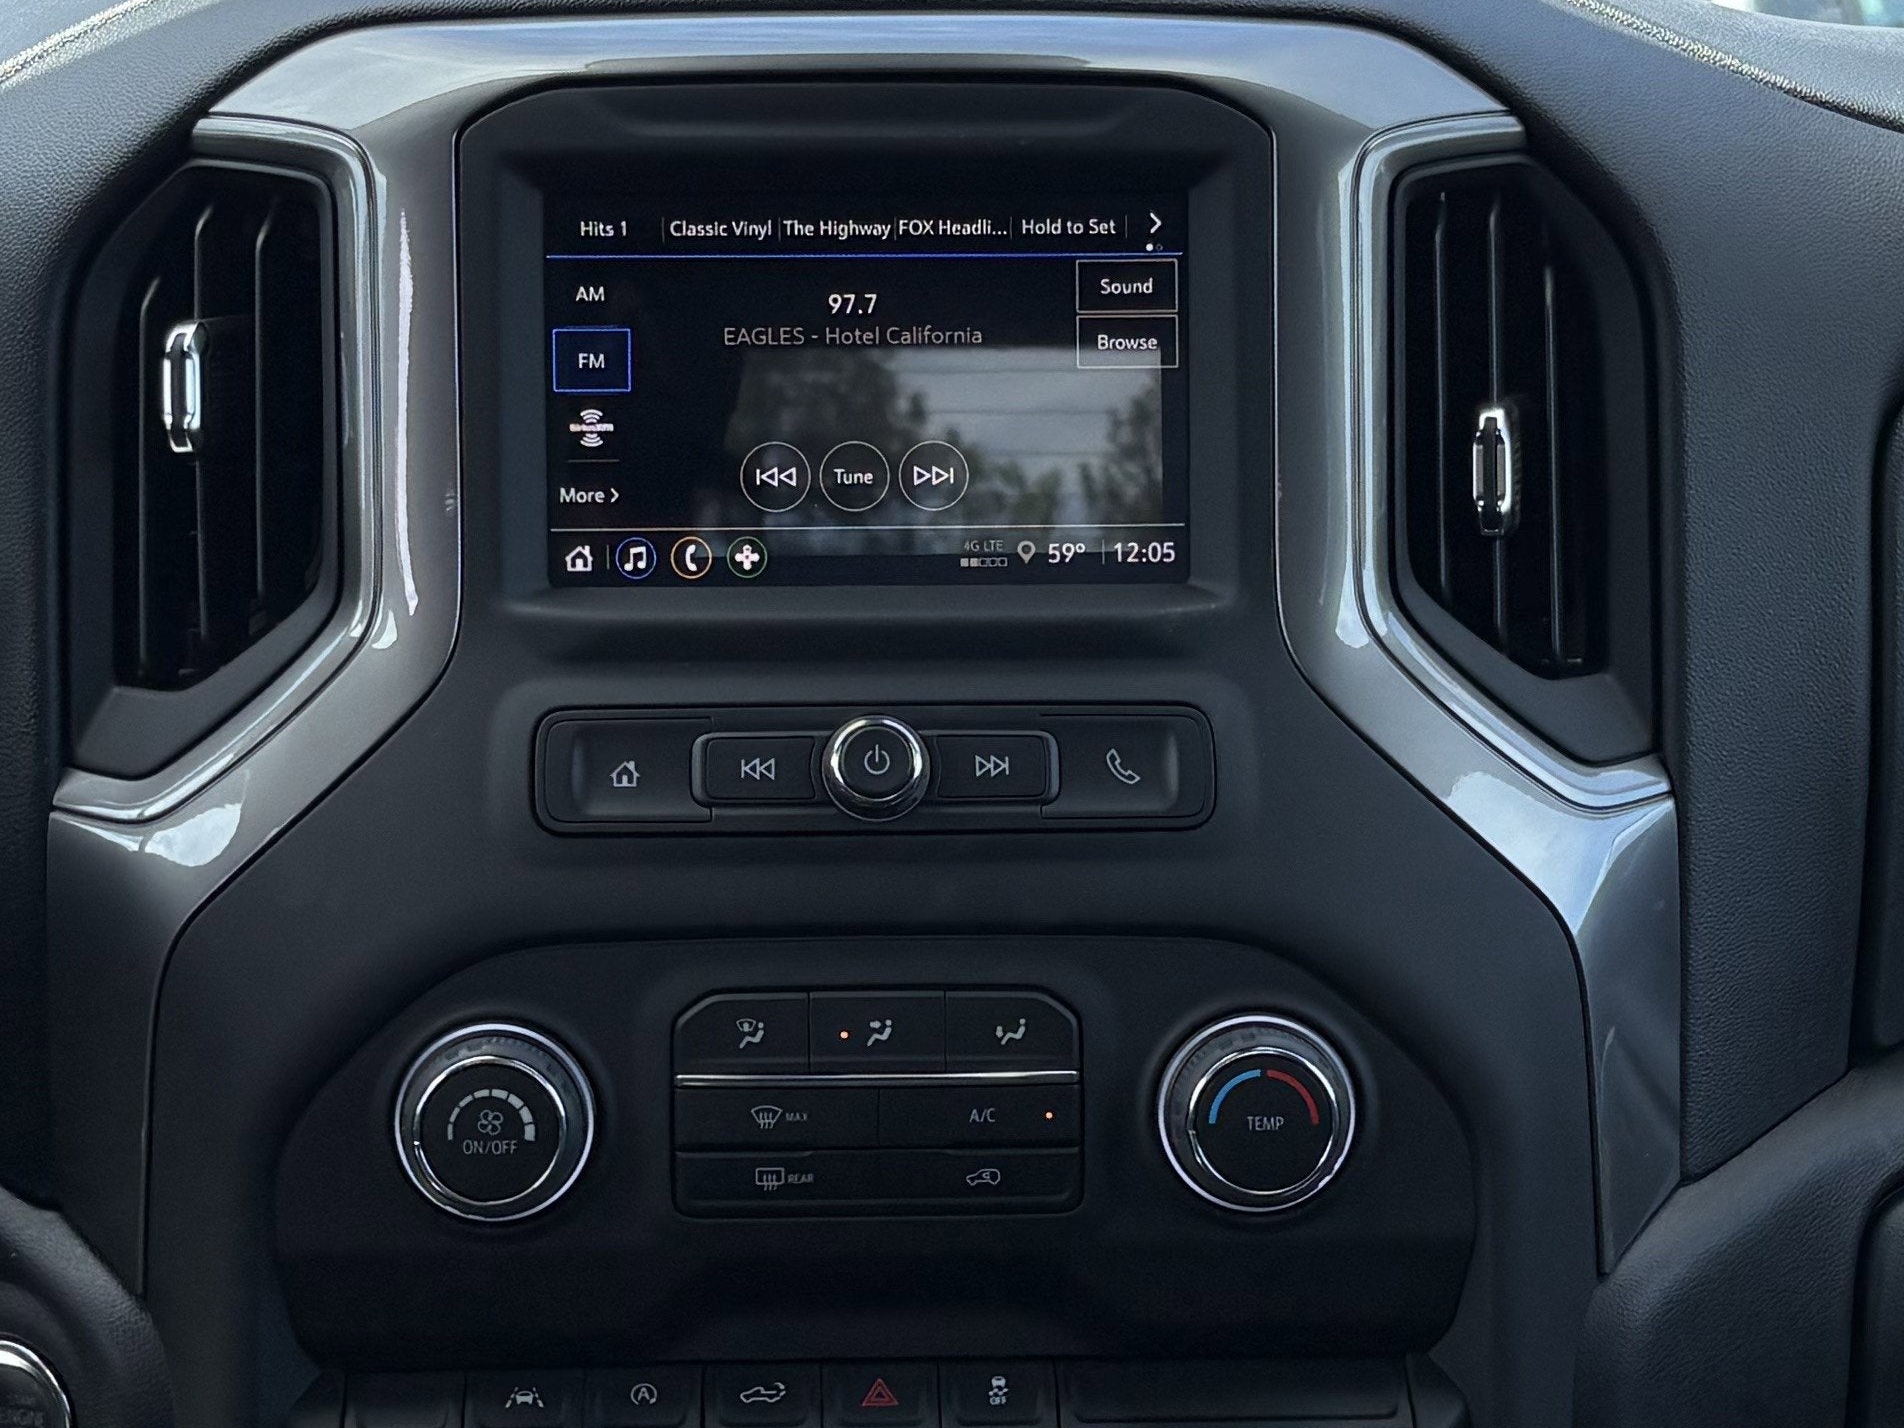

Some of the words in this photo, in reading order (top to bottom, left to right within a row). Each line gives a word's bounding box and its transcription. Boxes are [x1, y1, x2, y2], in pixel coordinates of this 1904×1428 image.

[580, 219, 612, 237] Hits
[620, 219, 627, 237] 1
[669, 219, 728, 238] Classic
[731, 218, 772, 242] Vinyl
[783, 219, 815, 237] The
[820, 218, 891, 242] Highway
[899, 219, 934, 237] FOX
[1021, 217, 1062, 237] Hold
[1065, 220, 1083, 237] to
[1088, 217, 1116, 235] Set
[575, 285, 605, 303] AM
[1100, 276, 1153, 295] Sound
[828, 293, 877, 315] 97.7
[723, 326, 805, 346] EAGLES
[825, 326, 881, 346] Hotel
[886, 326, 983, 346] California
[1097, 332, 1158, 351] Browse
[578, 352, 605, 369] FM
[833, 468, 874, 486] Tune
[559, 487, 606, 504] More
[963, 540, 980, 551] 4G
[983, 540, 1004, 551] LTE
[1114, 541, 1176, 563] 12:05
[969, 1108, 996, 1123] A/C
[1246, 1116, 1284, 1131] TEMP
[463, 1139, 518, 1154] ON/OFF
[787, 1174, 814, 1183] REAR
